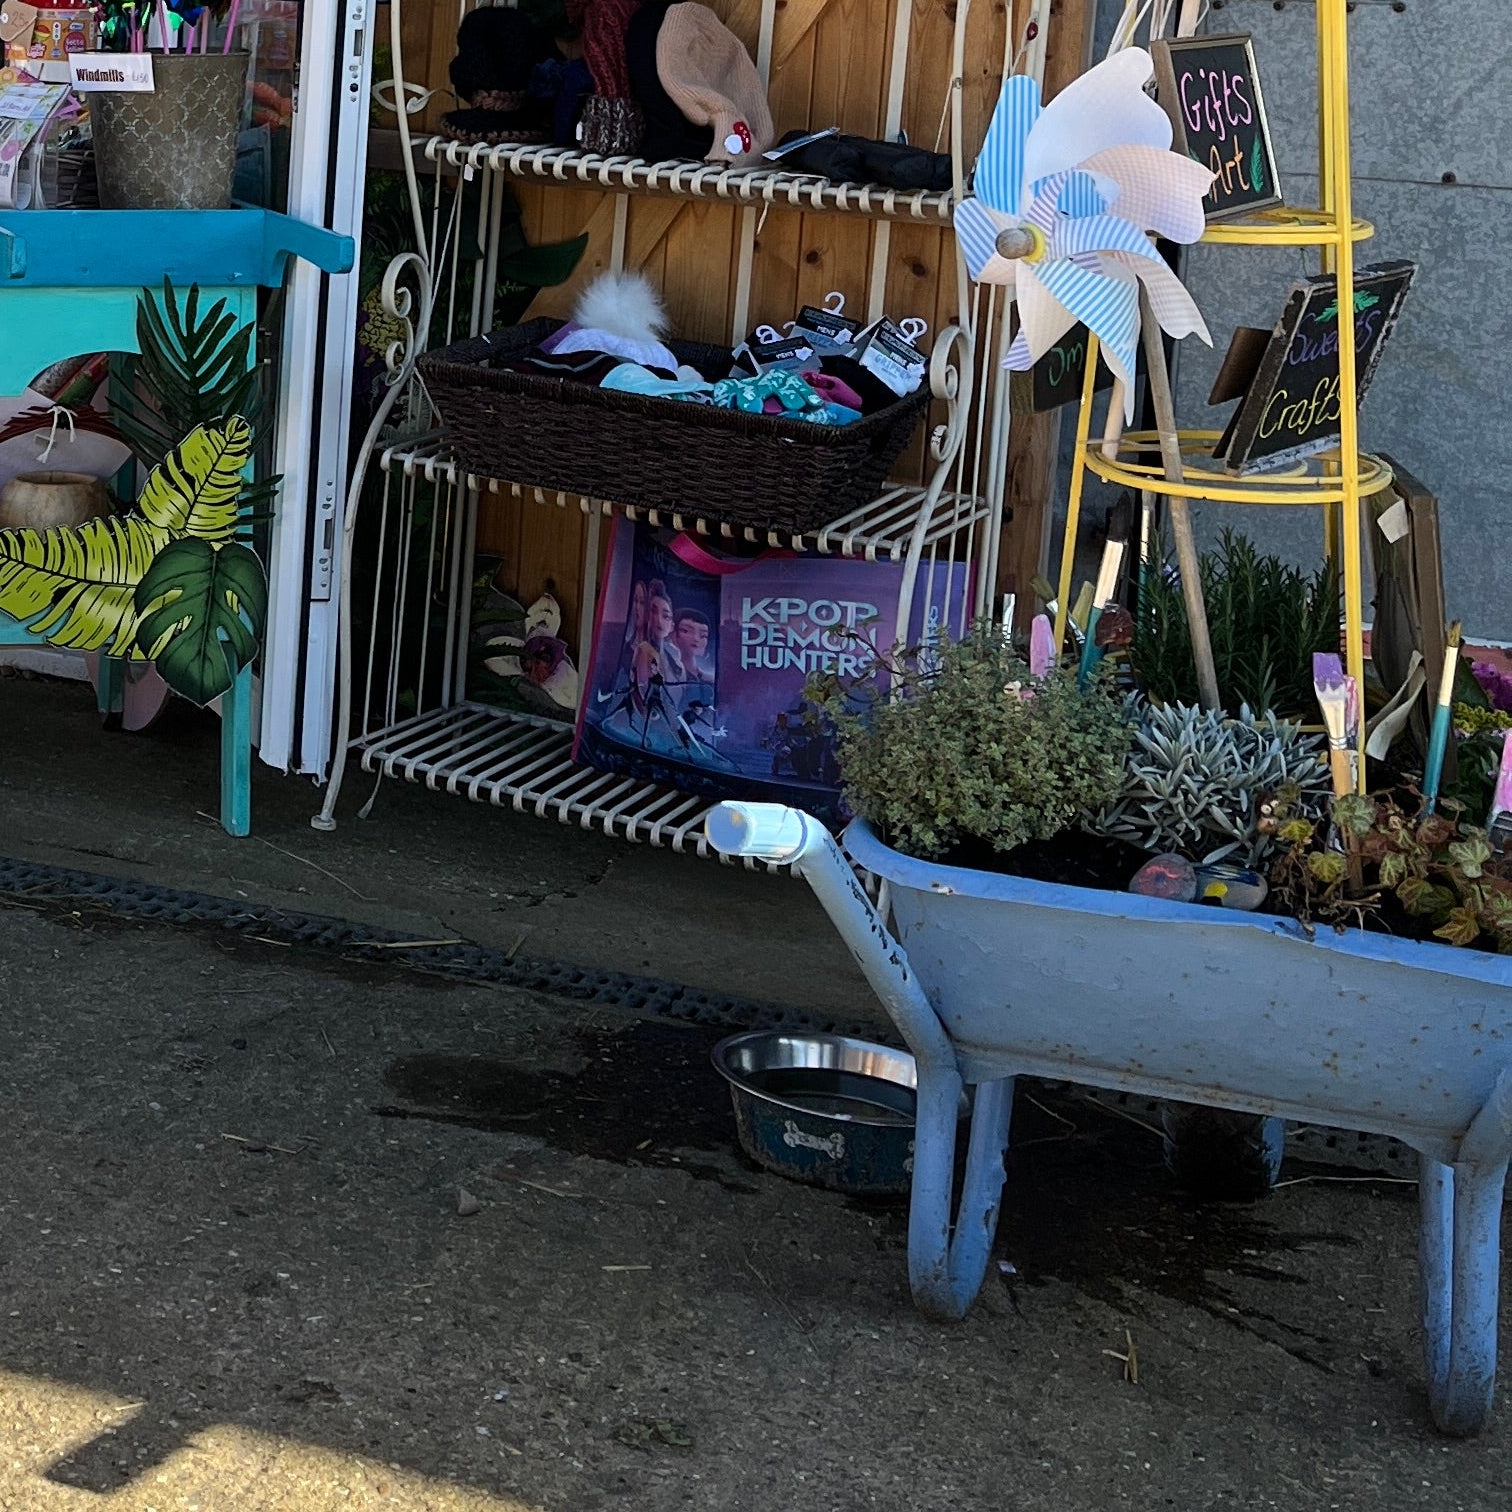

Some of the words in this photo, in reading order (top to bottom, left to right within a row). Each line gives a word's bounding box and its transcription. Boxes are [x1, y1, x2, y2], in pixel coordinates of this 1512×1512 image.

[75, 68, 125, 83] Windmills
[1180, 68, 1252, 141] Gifts
[1209, 134, 1250, 204] Art
[1289, 310, 1381, 366] Swets
[741, 622, 877, 652] DEMON
[741, 645, 877, 679] HUNTERS
